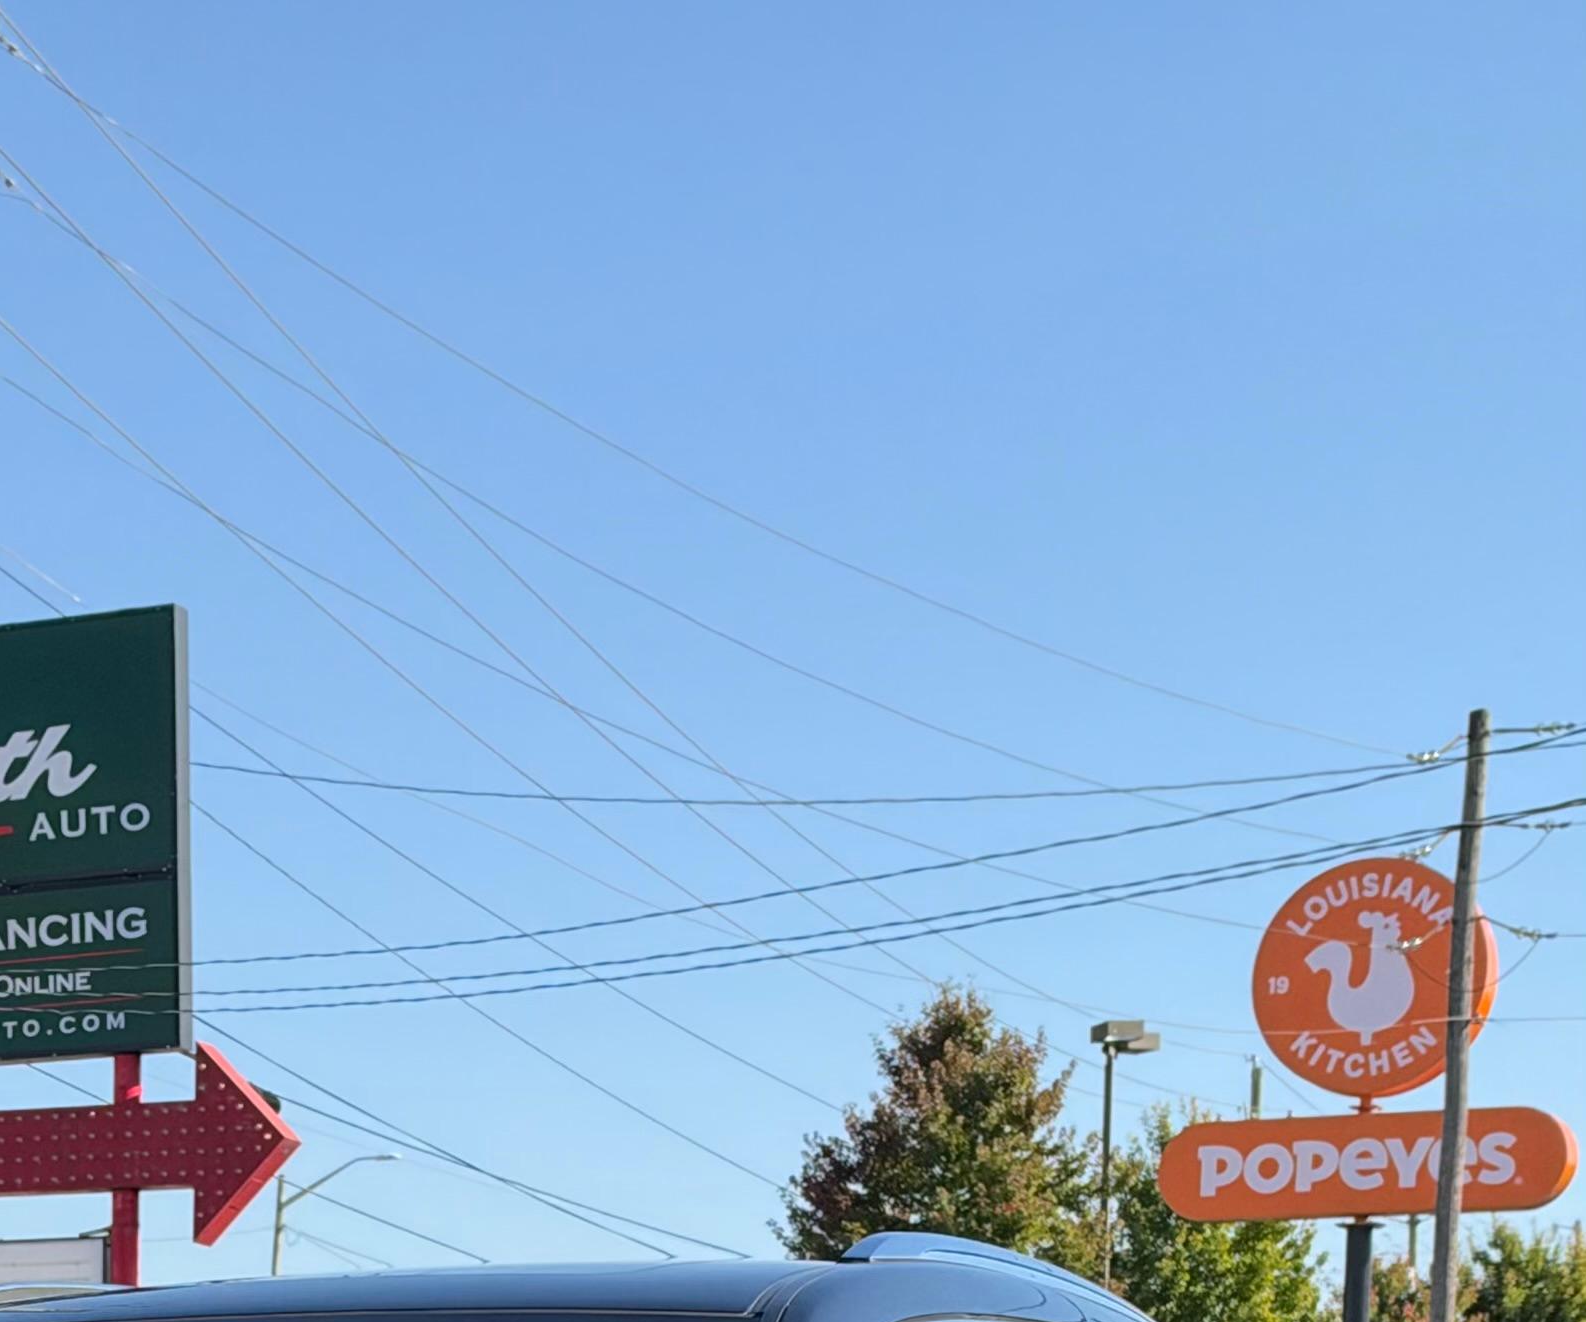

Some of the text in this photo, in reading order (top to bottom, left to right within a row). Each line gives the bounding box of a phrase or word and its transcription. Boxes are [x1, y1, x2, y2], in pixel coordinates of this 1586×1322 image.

[28, 802, 151, 842] AUTO
[1285, 872, 1454, 936] LOUISIANA
[1267, 976, 1290, 996] 19
[1290, 1025, 1439, 1079] KITCHEN
